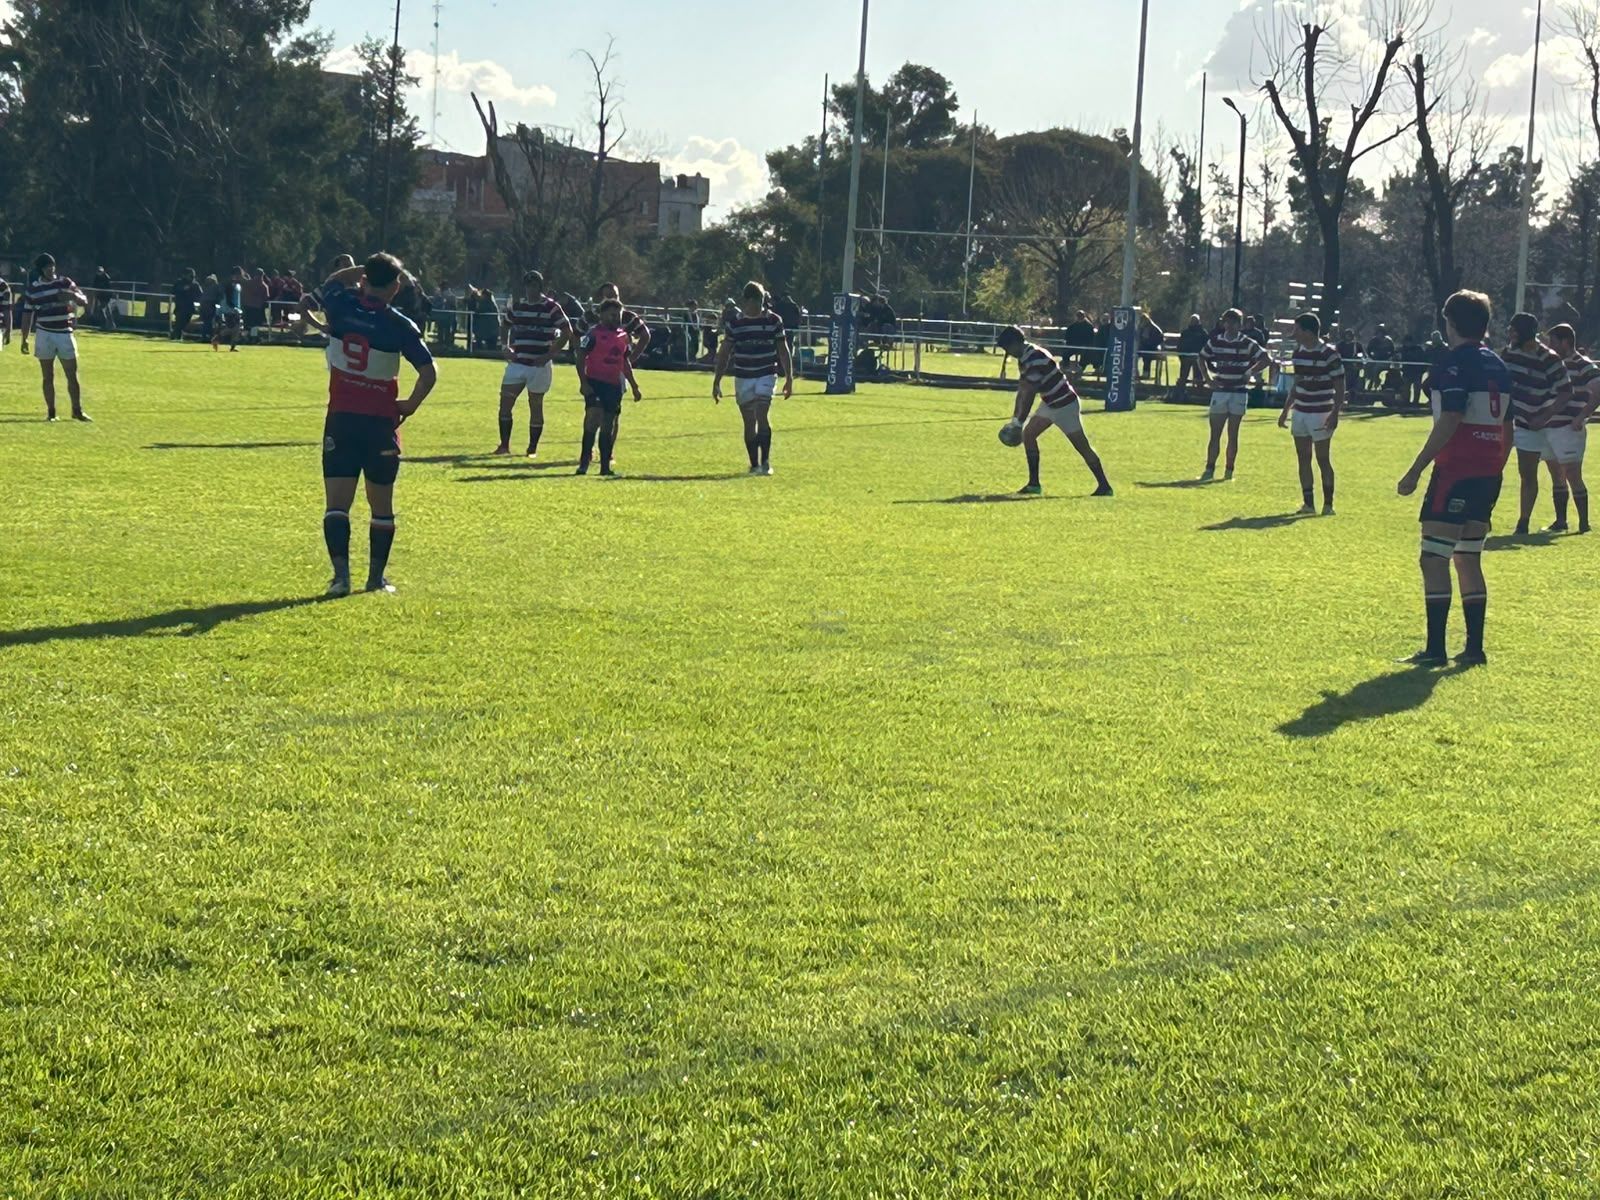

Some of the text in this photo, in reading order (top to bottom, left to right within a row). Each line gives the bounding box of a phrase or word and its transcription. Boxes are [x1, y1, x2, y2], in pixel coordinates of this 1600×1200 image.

[342, 333, 370, 372] 9
[828, 322, 840, 385] Grupolar
[1108, 337, 1123, 403] Grupolar
